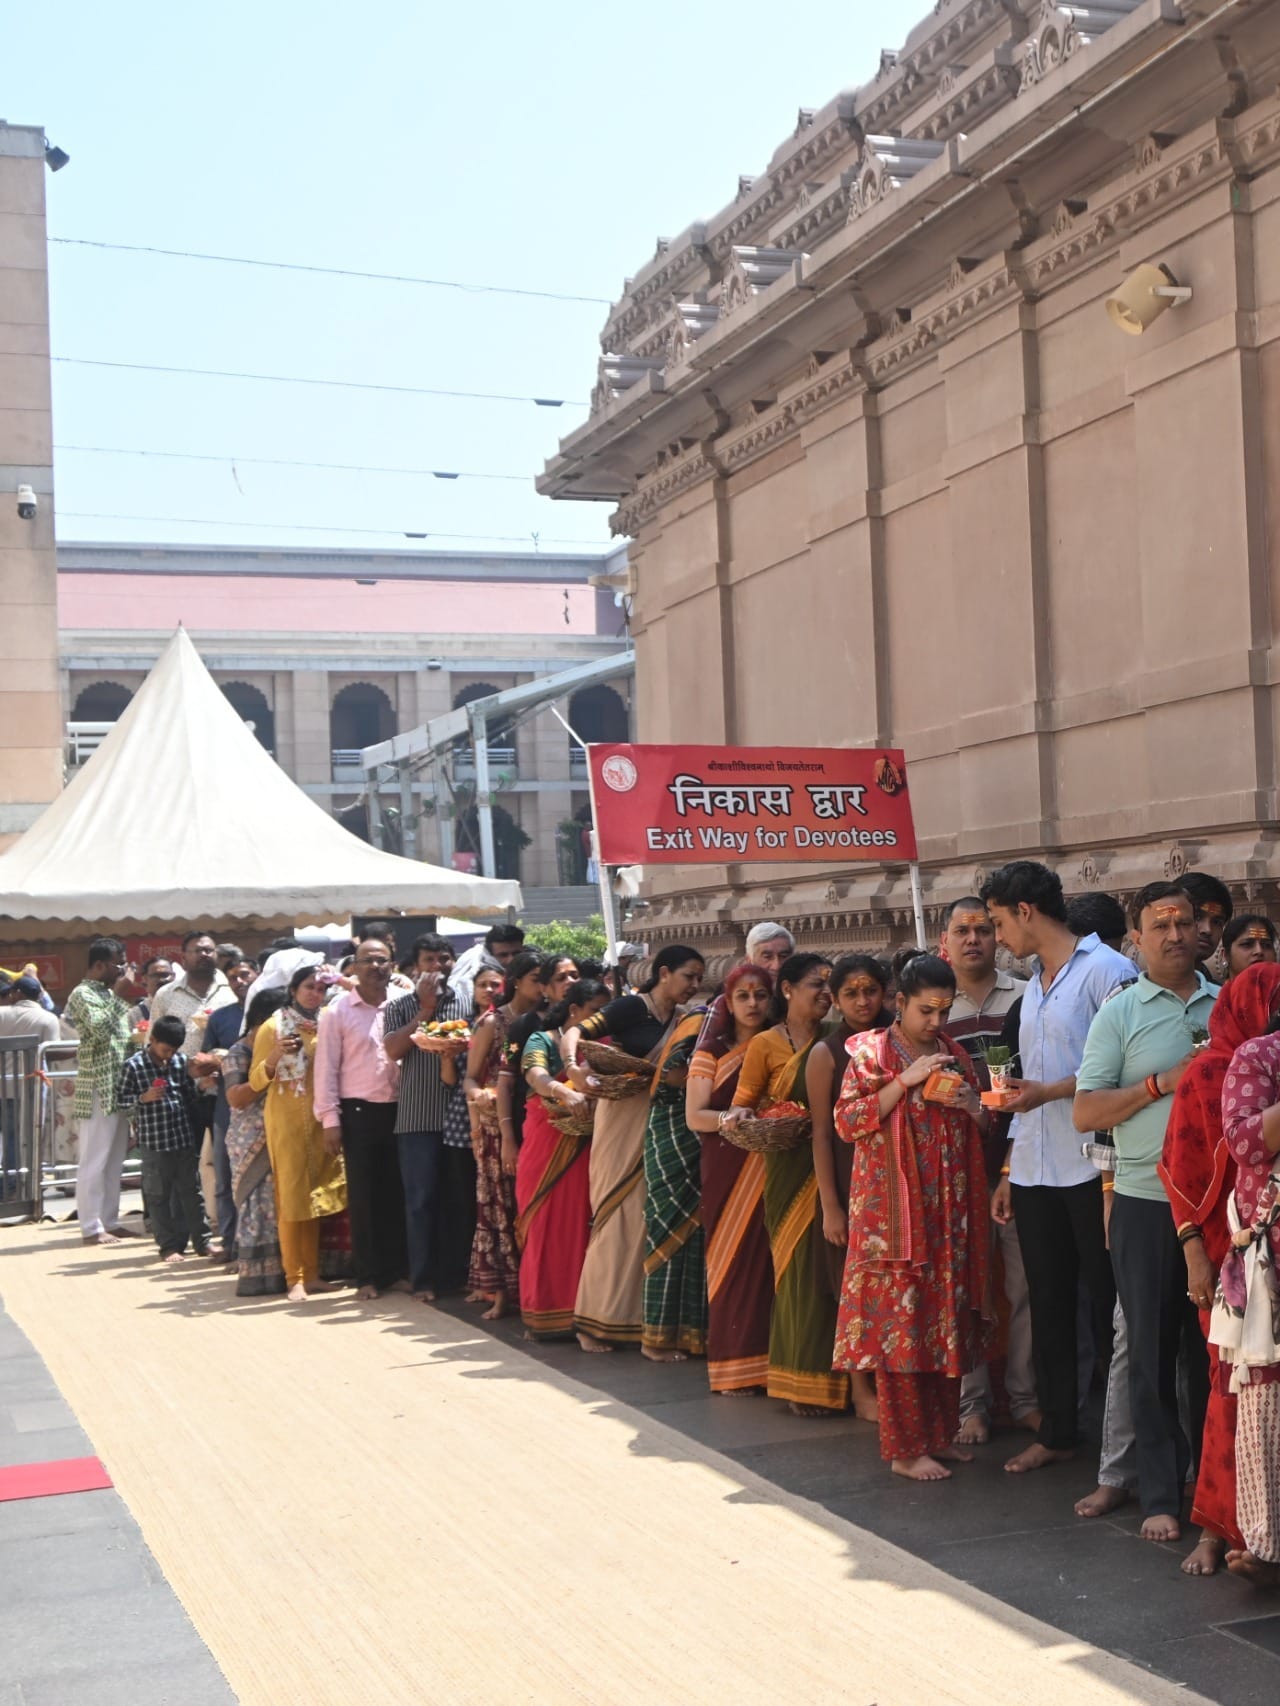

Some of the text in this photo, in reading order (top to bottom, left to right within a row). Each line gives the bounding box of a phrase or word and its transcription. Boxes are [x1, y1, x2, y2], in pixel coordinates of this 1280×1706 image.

[668, 774, 868, 819] निकास द्वार
[646, 826, 897, 853] Exit Way for Devotees
